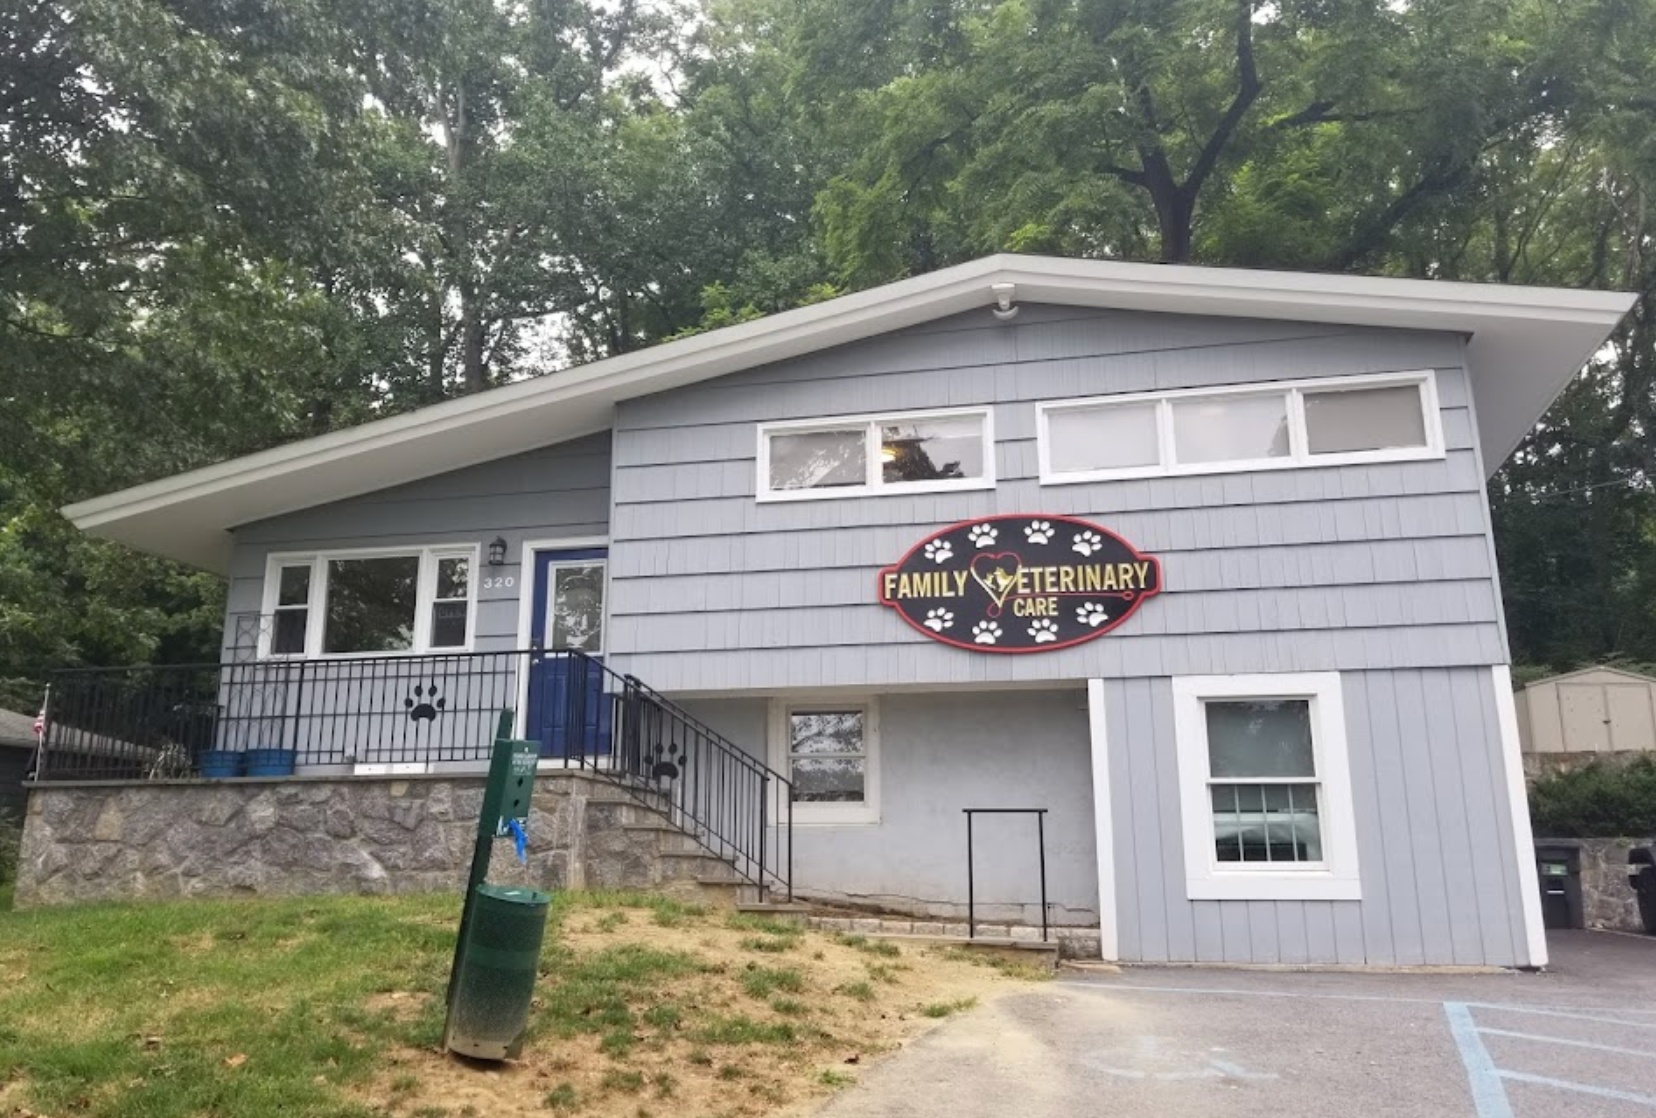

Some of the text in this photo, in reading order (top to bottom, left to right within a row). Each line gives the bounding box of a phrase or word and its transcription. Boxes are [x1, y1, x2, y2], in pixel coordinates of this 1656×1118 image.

[483, 577, 515, 589] 320
[883, 570, 968, 599] FAMILY
[1013, 597, 1059, 617] CARE
